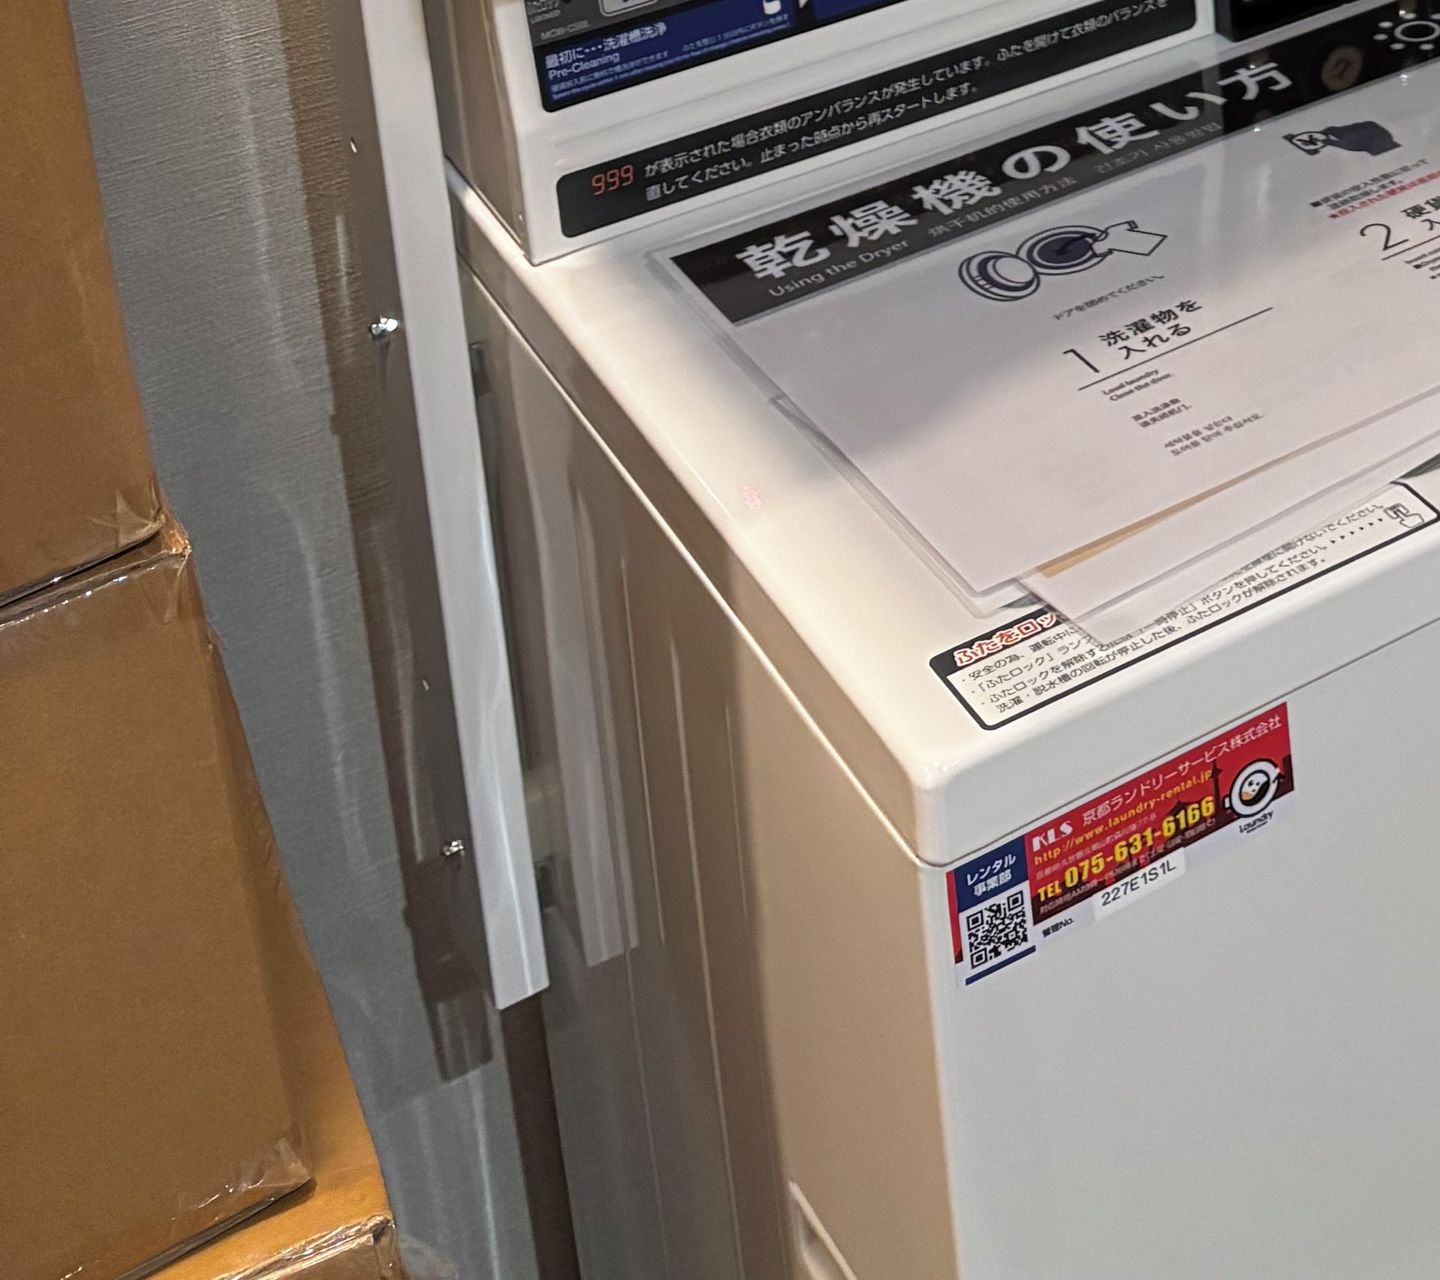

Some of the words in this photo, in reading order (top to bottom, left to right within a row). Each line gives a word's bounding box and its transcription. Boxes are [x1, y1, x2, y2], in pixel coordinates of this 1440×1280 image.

[549, 52, 620, 80] Pre-Cleaning
[592, 164, 634, 197] 999
[734, 60, 1294, 285] 乾燥機の使い方
[1359, 223, 1409, 251] 2
[768, 268, 828, 301] Using
[830, 259, 858, 282] the
[860, 238, 910, 276] Dryer
[1063, 348, 1100, 373] 1
[1118, 323, 1192, 360] 入れる
[1099, 299, 1203, 348] 洗濯物を
[1082, 715, 1282, 826] 京都ランドリーサービス株式会社
[966, 854, 1016, 885] レンタル
[1037, 880, 1062, 902] TEL
[1064, 795, 1215, 889] 075-631-6166
[1101, 860, 1177, 907] 227E1S1L
